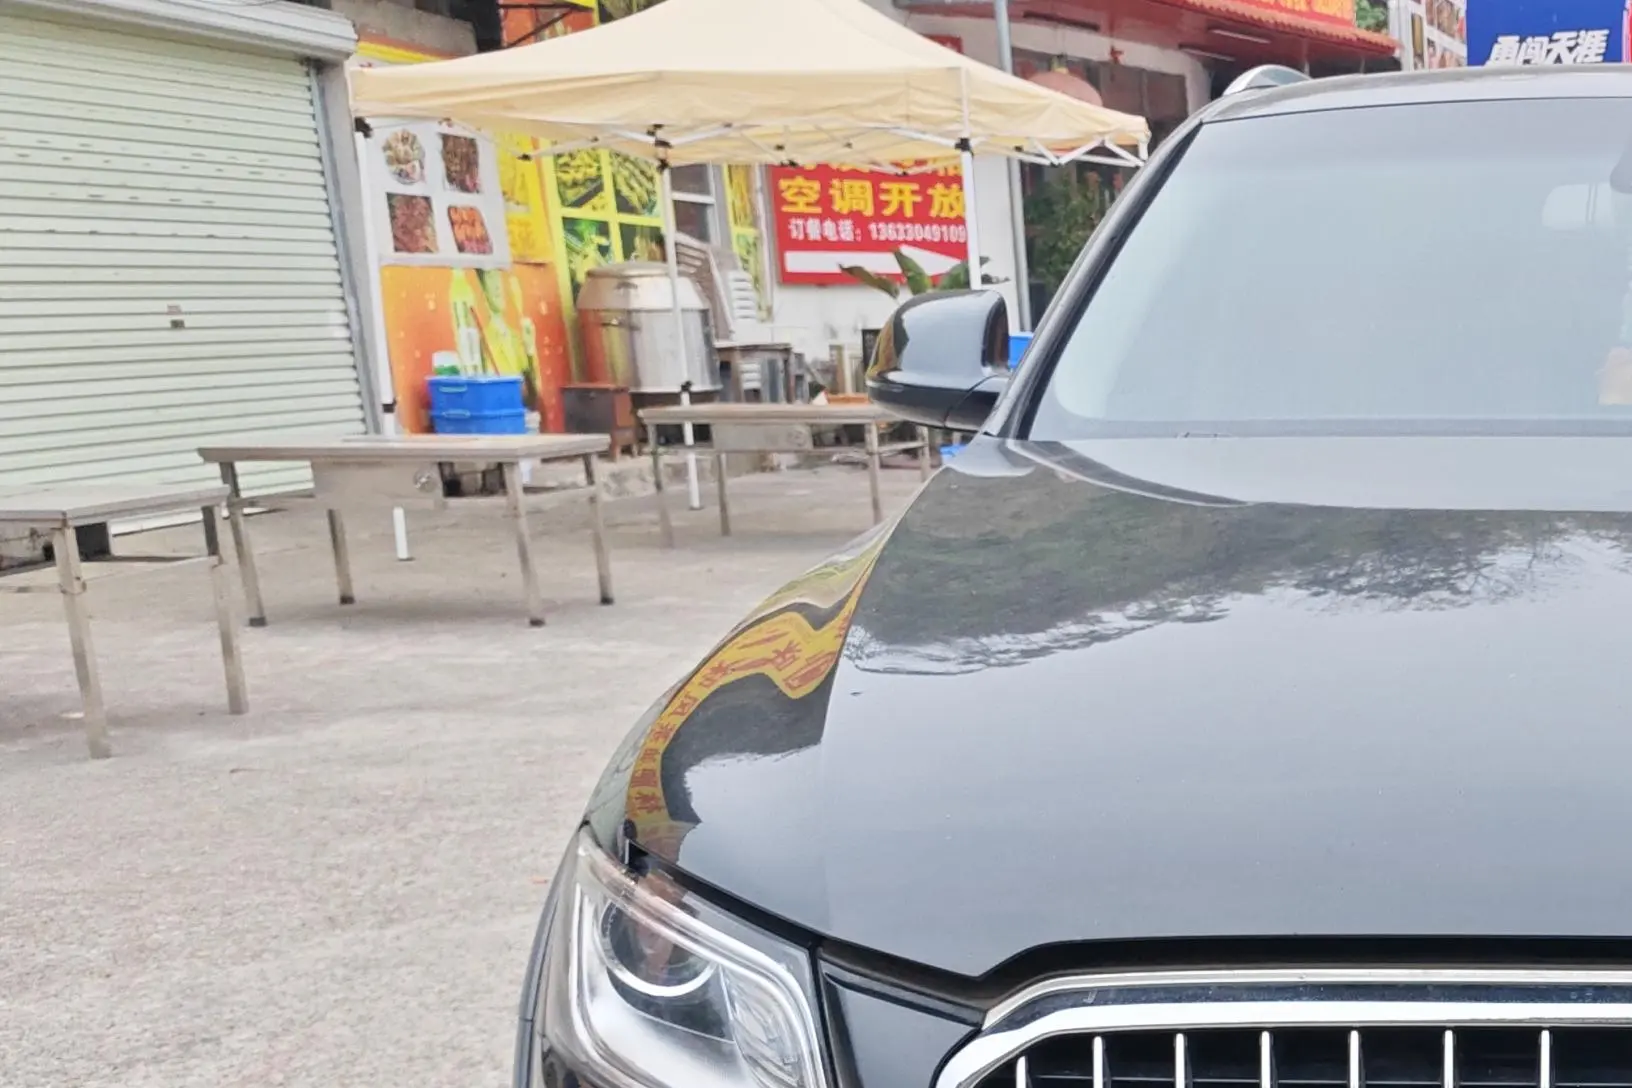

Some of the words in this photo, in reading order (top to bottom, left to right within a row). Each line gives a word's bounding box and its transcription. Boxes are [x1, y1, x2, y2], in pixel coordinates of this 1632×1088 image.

[1486, 29, 1609, 64] 勇闯天涯
[778, 175, 965, 218] 空调开放
